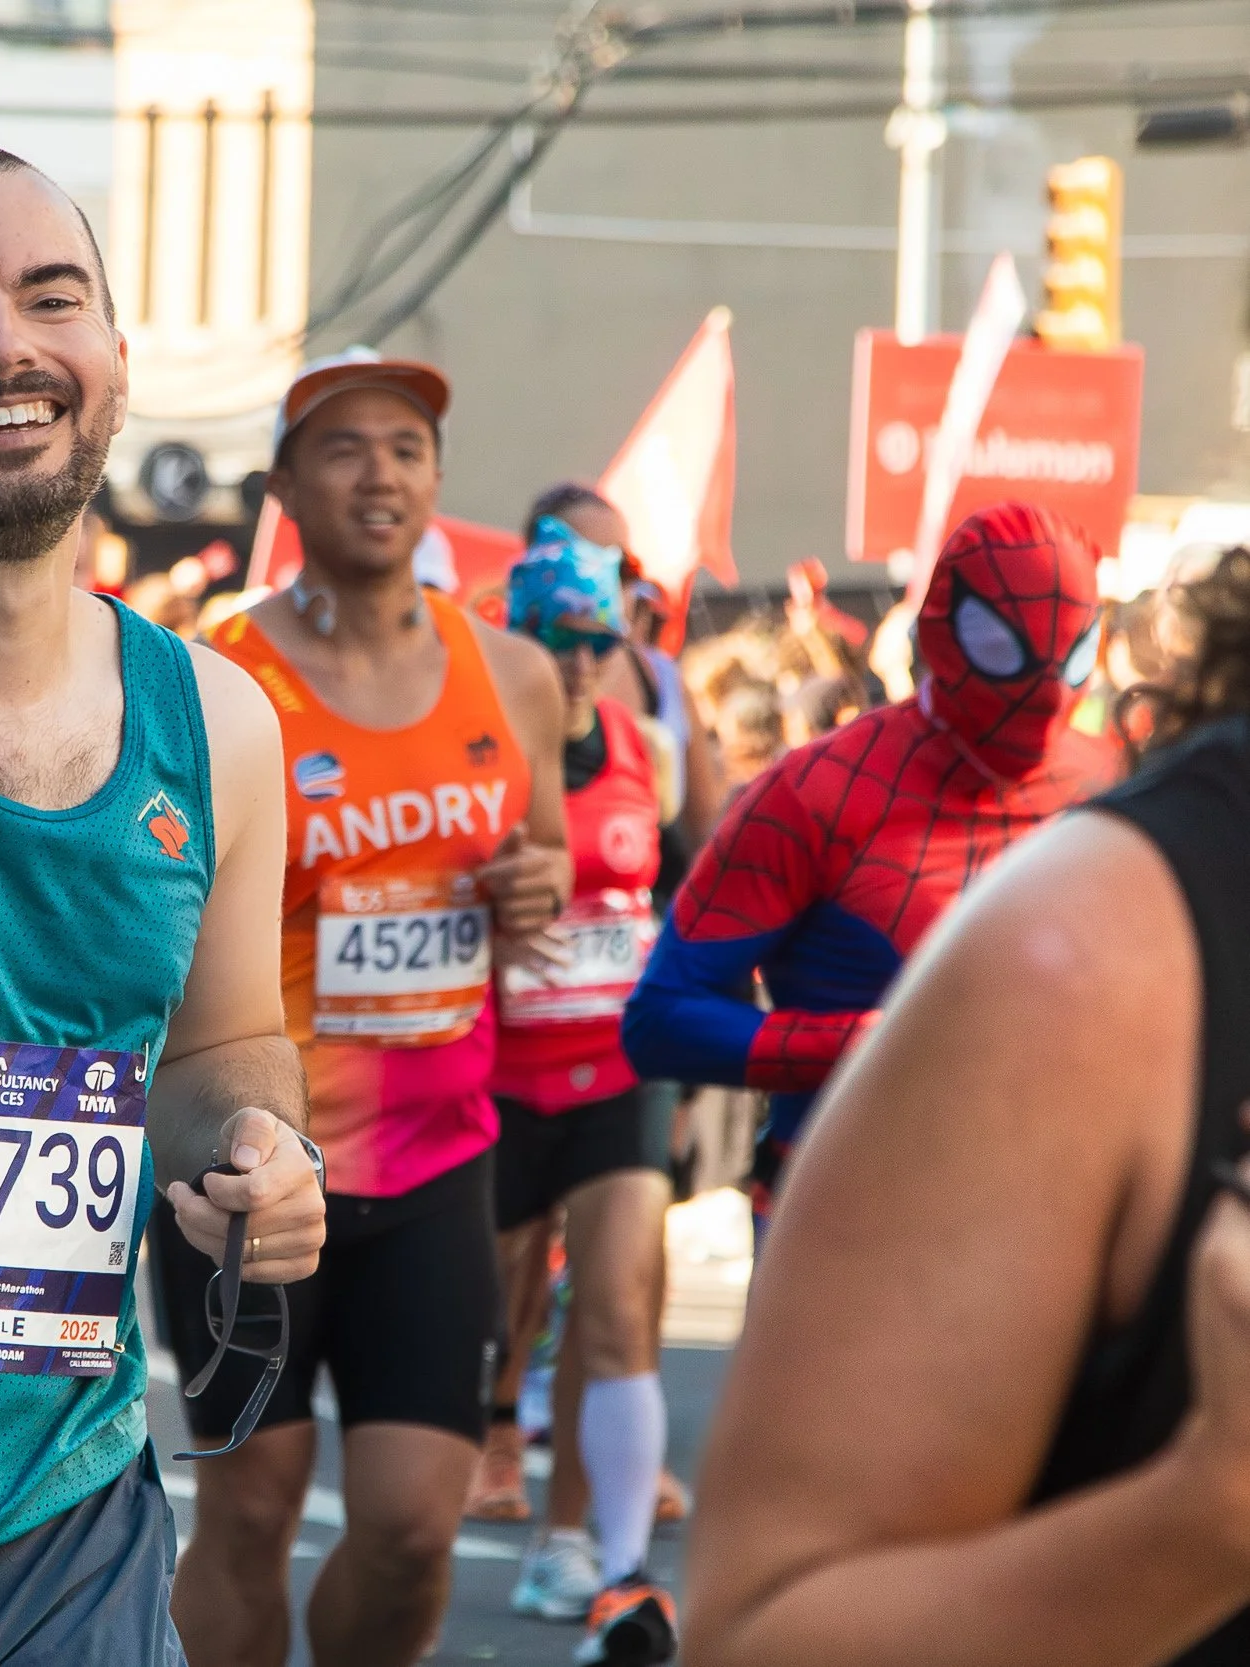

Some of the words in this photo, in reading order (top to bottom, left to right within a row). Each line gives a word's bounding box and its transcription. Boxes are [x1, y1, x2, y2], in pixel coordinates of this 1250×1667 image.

[302, 779, 508, 869] ANDRY
[336, 912, 481, 974] 45219
[78, 1095, 116, 1114] TATA
[12, 1316, 26, 1337] E
[60, 1319, 100, 1341] 2025
